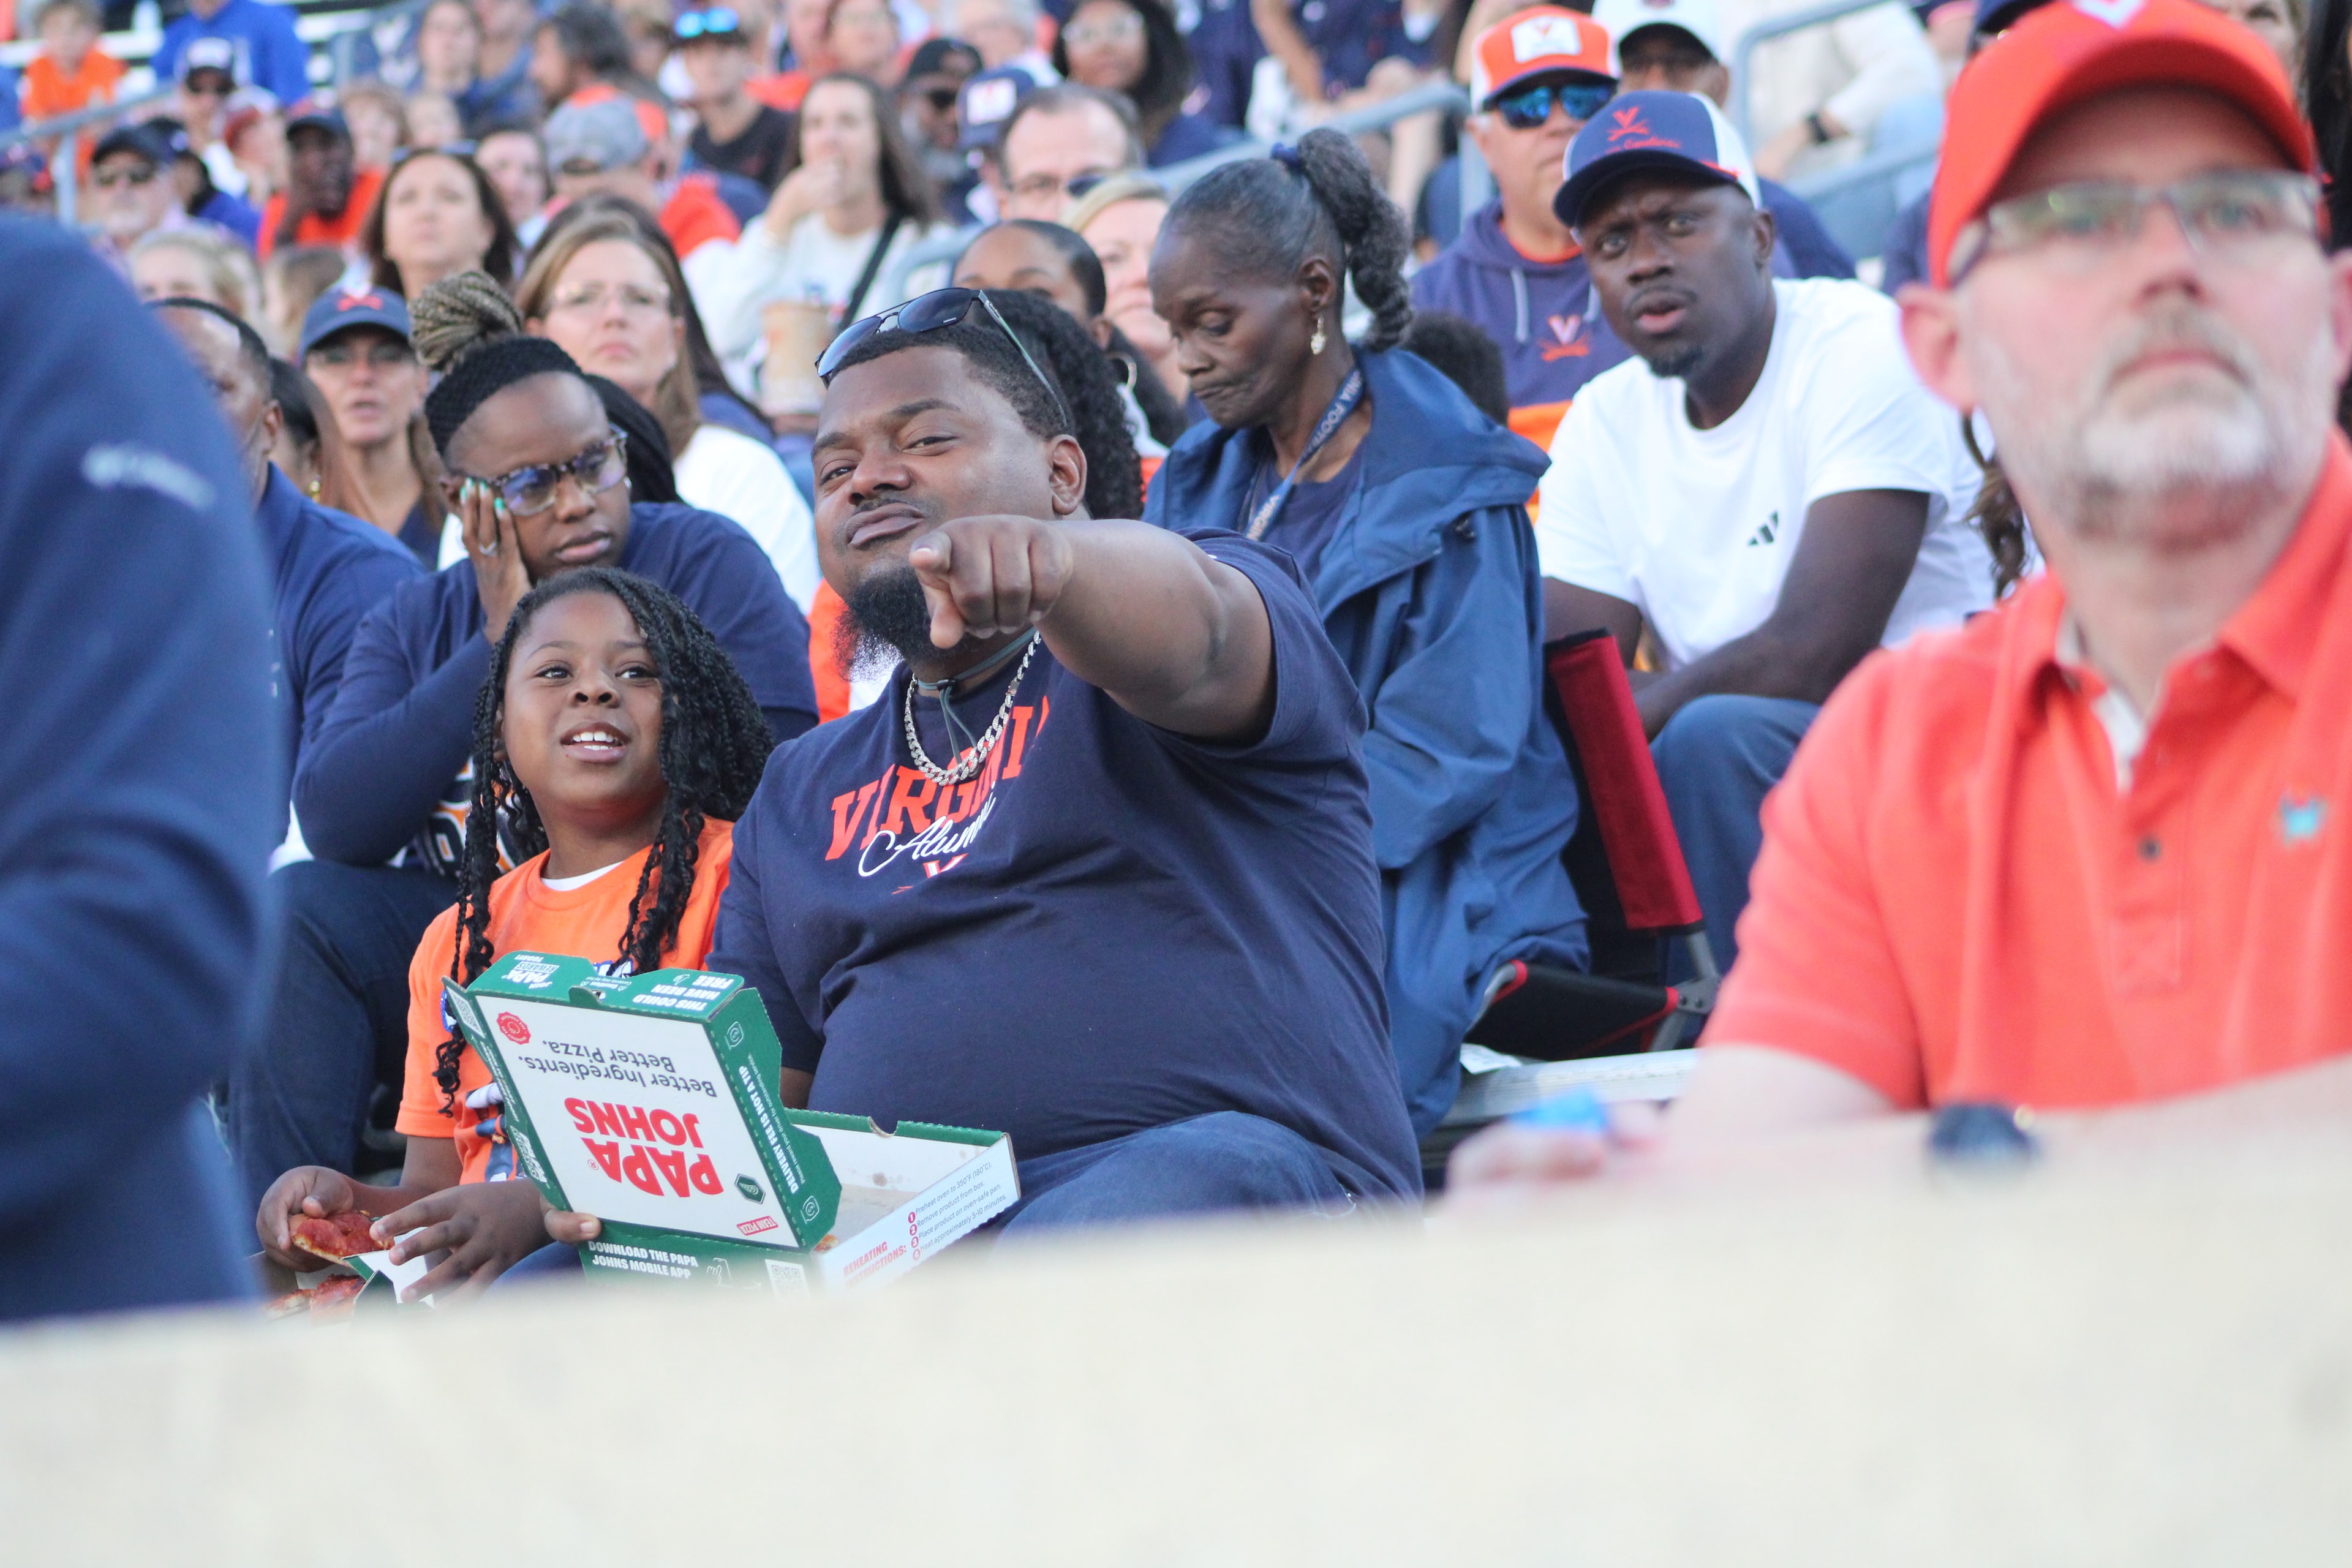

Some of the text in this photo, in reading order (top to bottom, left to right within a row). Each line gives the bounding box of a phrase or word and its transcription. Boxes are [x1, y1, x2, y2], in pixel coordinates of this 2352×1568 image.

[859, 781, 996, 877] Alumni
[518, 962, 557, 973] REWARDS
[650, 984, 720, 1000] HAVE BEEN
[692, 975, 734, 989] FREE
[632, 994, 707, 1011] THIS COULD
[543, 1040, 676, 1072] Better Pizza.
[518, 1055, 717, 1097] Better Ingredients.
[756, 1073, 773, 1107] outstanding
[564, 1097, 704, 1148] JOHNS
[739, 1066, 799, 1194] DELIVERY FEE IS NOT A TIP
[774, 1115, 784, 1133] driver
[781, 1132, 790, 1145] your
[581, 1137, 724, 1197] PAPA
[786, 1145, 797, 1165] reward
[796, 1164, 805, 1184] Please
[915, 1197, 937, 1215] Preheat
[937, 1191, 950, 1202] oven
[916, 1209, 938, 1227] Remove
[938, 1196, 960, 1215] product
[960, 1189, 973, 1200] from
[973, 1181, 985, 1190] box.
[918, 1226, 934, 1240] Place
[934, 1213, 956, 1232] product
[956, 1207, 963, 1216] on
[963, 1190, 990, 1212] oven-safe
[990, 1183, 1002, 1196] pan.
[739, 1216, 777, 1234] TEAM PIZZA
[920, 1240, 934, 1252] Heat
[933, 1215, 972, 1245] approximately
[972, 1208, 984, 1219] 5-10
[984, 1194, 1007, 1212] minutes.
[588, 1240, 699, 1267] DOWNLOAD THE PAPA
[592, 1254, 692, 1279] JOHNS MOBILE APP
[843, 1241, 888, 1278] REHEATING
